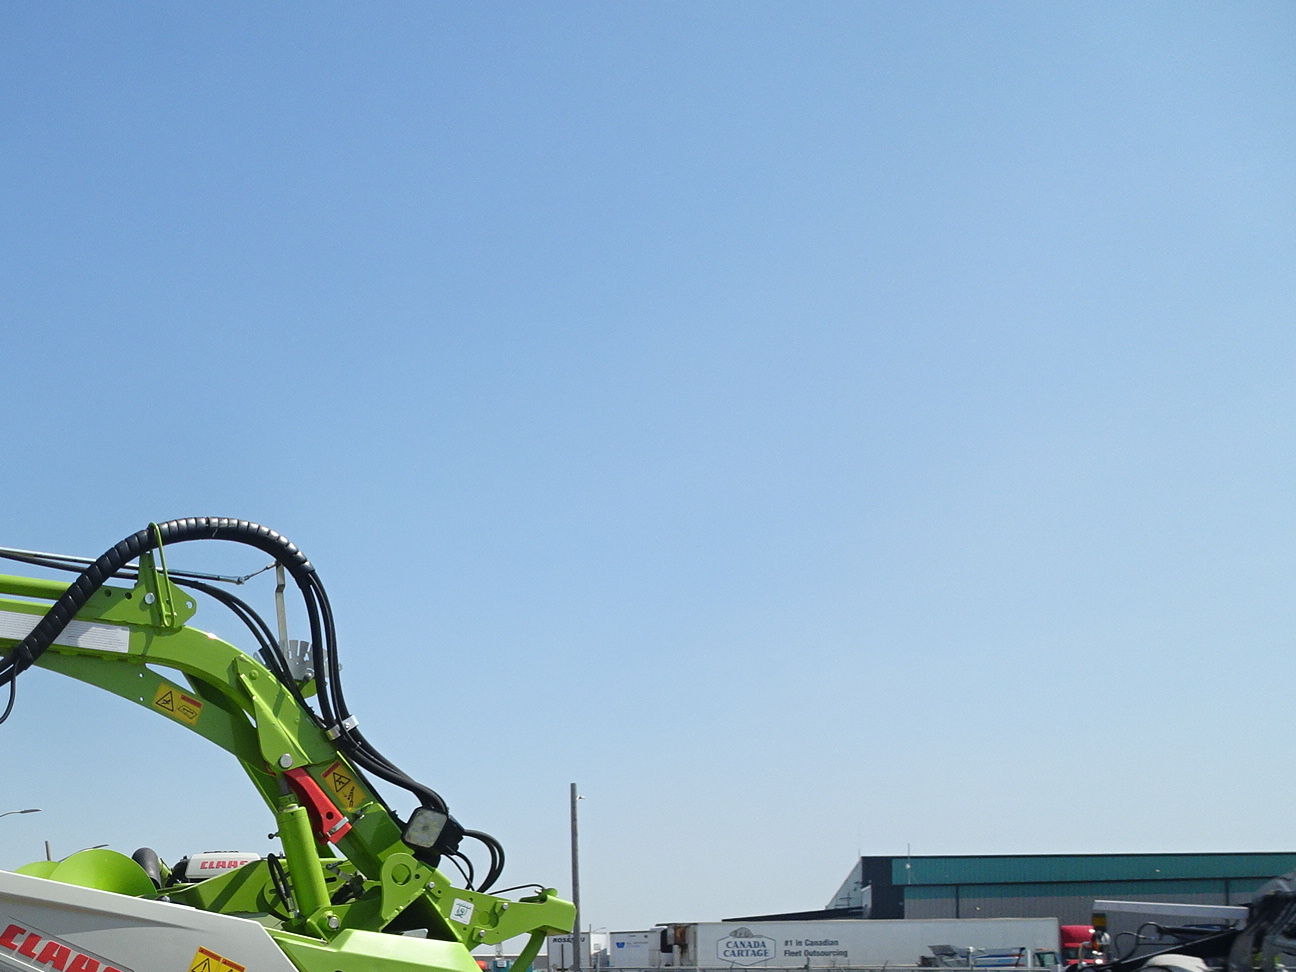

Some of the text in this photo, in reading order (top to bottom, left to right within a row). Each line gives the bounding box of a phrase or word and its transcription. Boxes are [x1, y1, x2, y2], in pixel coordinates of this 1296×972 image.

[726, 941, 767, 949] CANADA
[796, 939, 803, 947] in
[804, 939, 839, 947] Canadian
[724, 949, 770, 957] CARTAGE
[784, 949, 848, 958] Fleet Outsourcing
